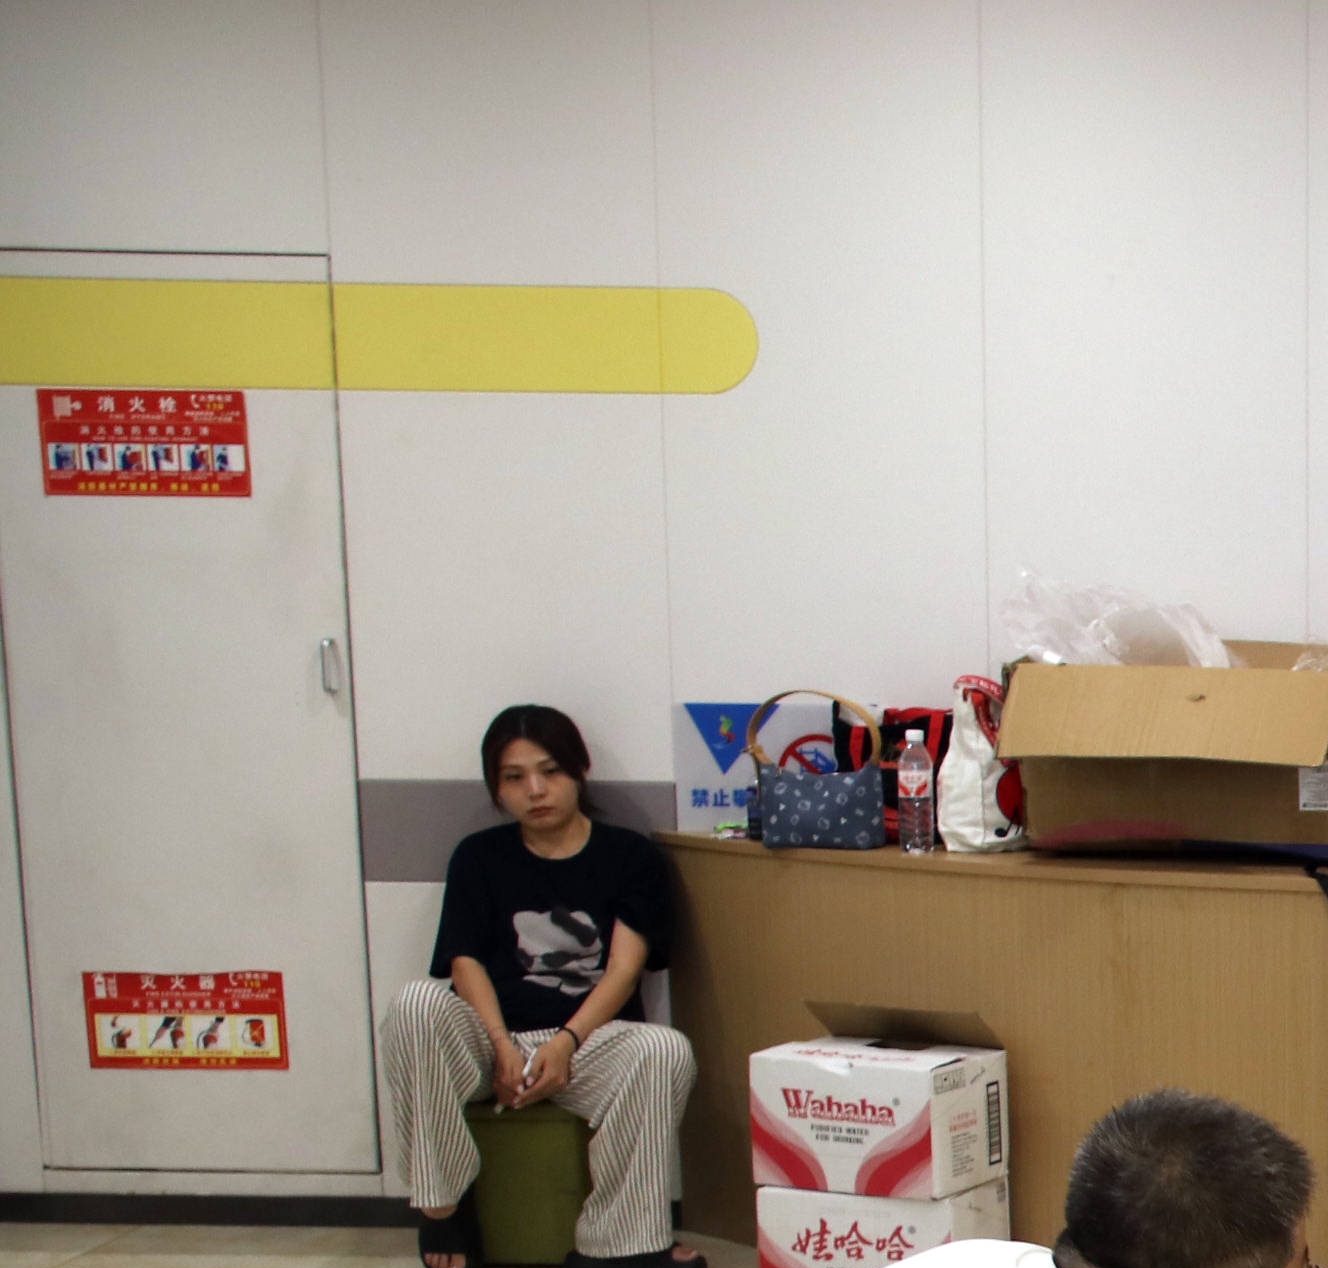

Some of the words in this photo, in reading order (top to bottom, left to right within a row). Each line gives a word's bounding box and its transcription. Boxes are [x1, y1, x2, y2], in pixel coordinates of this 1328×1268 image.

[97, 395, 177, 413] 消火栓
[140, 974, 216, 990] 灭火器
[781, 1088, 896, 1126] Wahaha
[791, 1217, 914, 1261] 娃哈哈
